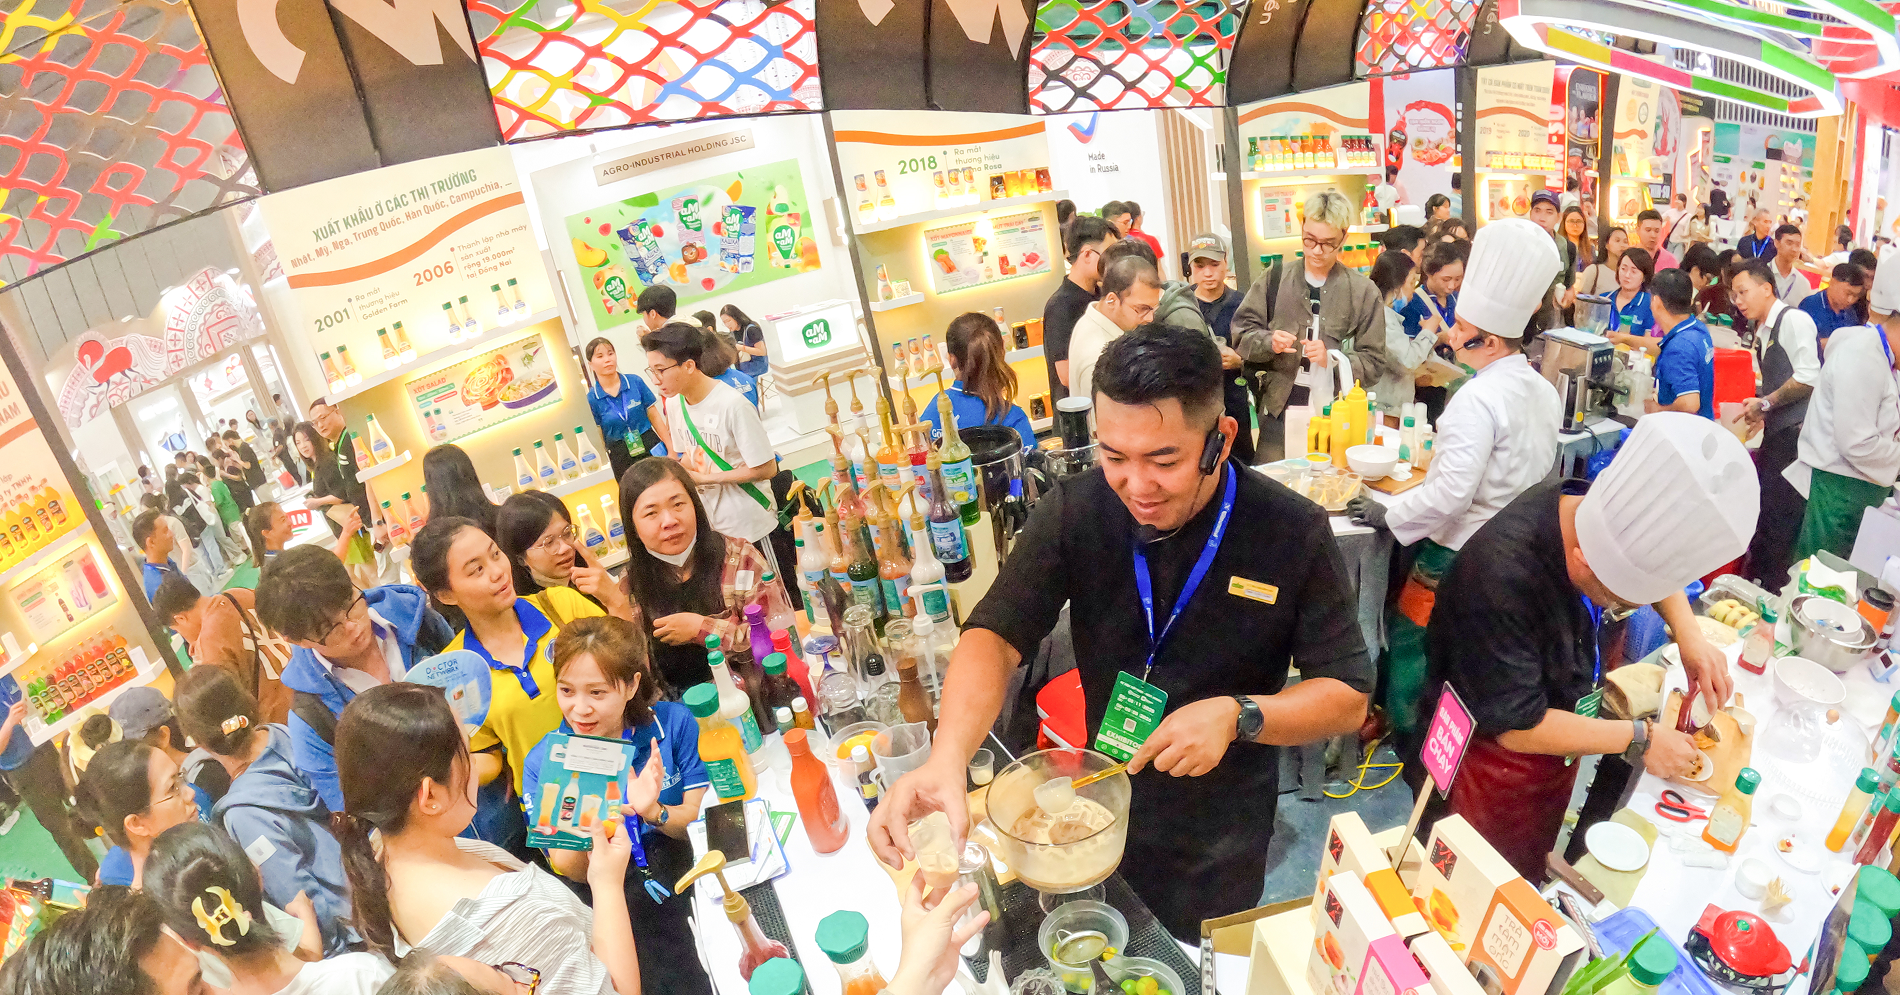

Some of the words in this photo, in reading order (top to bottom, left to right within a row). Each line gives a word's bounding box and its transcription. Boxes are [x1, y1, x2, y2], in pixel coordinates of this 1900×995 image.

[602, 149, 687, 177] AGRO-INDUSTRIAL
[687, 139, 728, 155] HOLDING
[729, 135, 747, 145] JSC
[953, 148, 964, 156] Ra
[1088, 150, 1105, 161] Made
[898, 155, 937, 175] 2018
[984, 163, 1002, 171] Rosa
[1089, 165, 1096, 173] in
[1097, 162, 1119, 173] Russia
[312, 217, 341, 243] XUẤT
[342, 205, 374, 230] KHẦU
[385, 193, 409, 213] CÁC
[409, 185, 430, 203] THỊ
[430, 168, 477, 196] TRƯỜNG
[331, 237, 353, 251] Nga,
[352, 225, 379, 242] Trung
[379, 215, 405, 232] Quốc,
[404, 208, 423, 222] Hàn
[423, 199, 449, 215] Quốc,
[449, 180, 503, 205] Campuchia,
[457, 239, 481, 252] Thành
[495, 229, 510, 239] nhà
[511, 224, 527, 233] máy
[413, 260, 454, 287] 2006
[498, 258, 512, 268] Nai
[355, 294, 365, 302] Ra
[362, 306, 388, 320] Golden
[388, 298, 408, 309] Farm
[314, 307, 350, 333] 2001
[426, 377, 447, 390] SALAD
[11, 473, 33, 491] TNHH
[1436, 725, 1455, 758] BÁN
[1429, 737, 1452, 774] CHẠY
[1503, 914, 1522, 939] TRÀ
